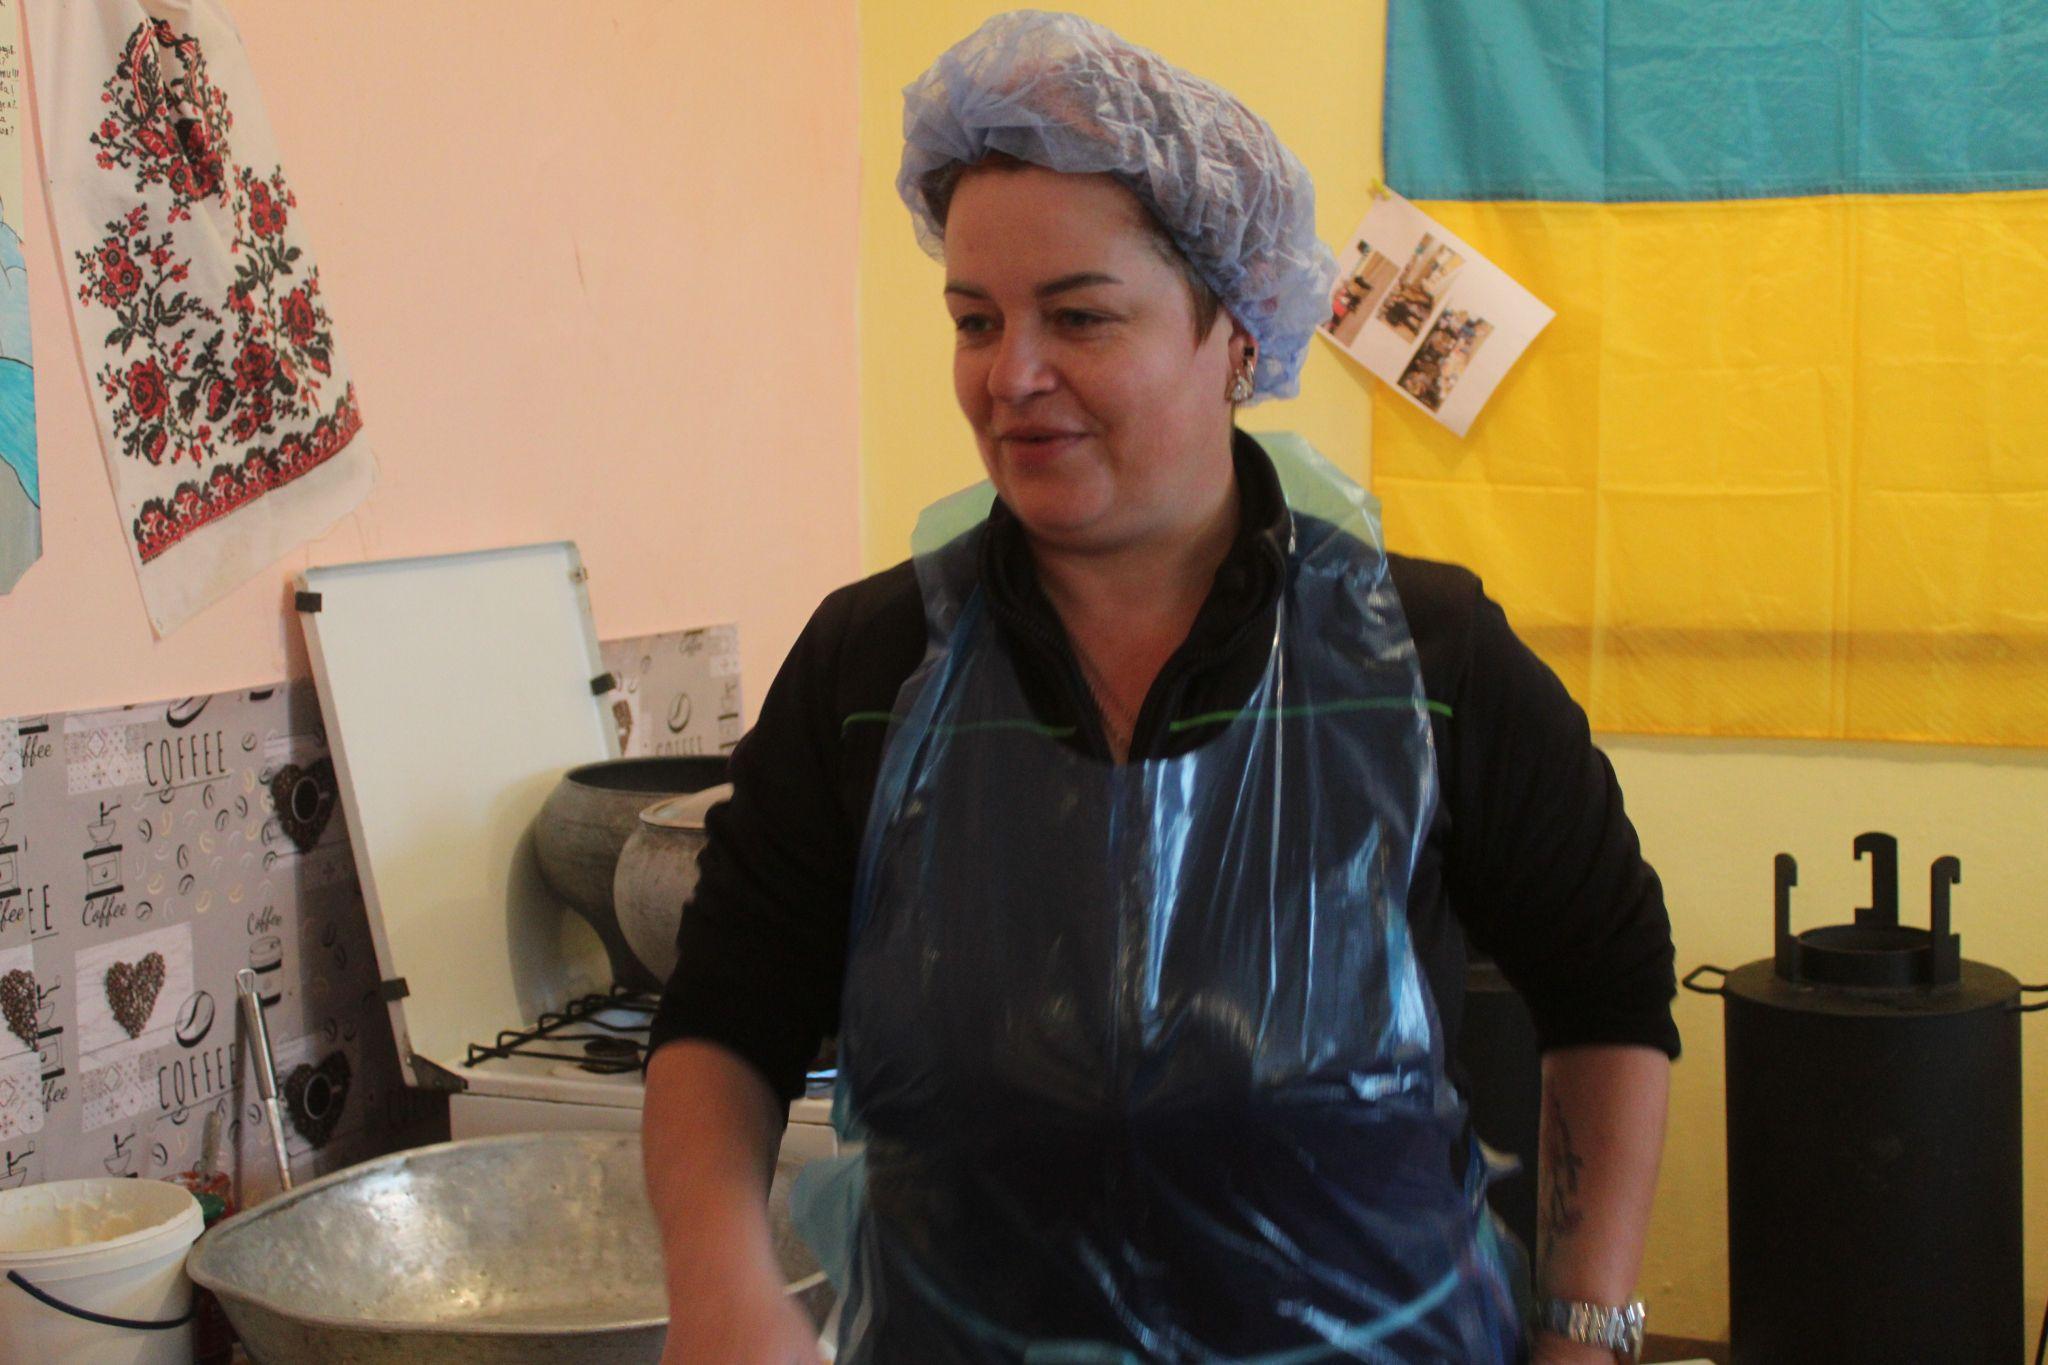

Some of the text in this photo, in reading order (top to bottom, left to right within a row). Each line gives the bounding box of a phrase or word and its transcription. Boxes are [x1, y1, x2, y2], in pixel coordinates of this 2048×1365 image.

[144, 730, 225, 786] COFFEE
[82, 895, 127, 928] Coffee
[247, 904, 282, 935] Coffee
[158, 1043, 237, 1110] COFFEE
